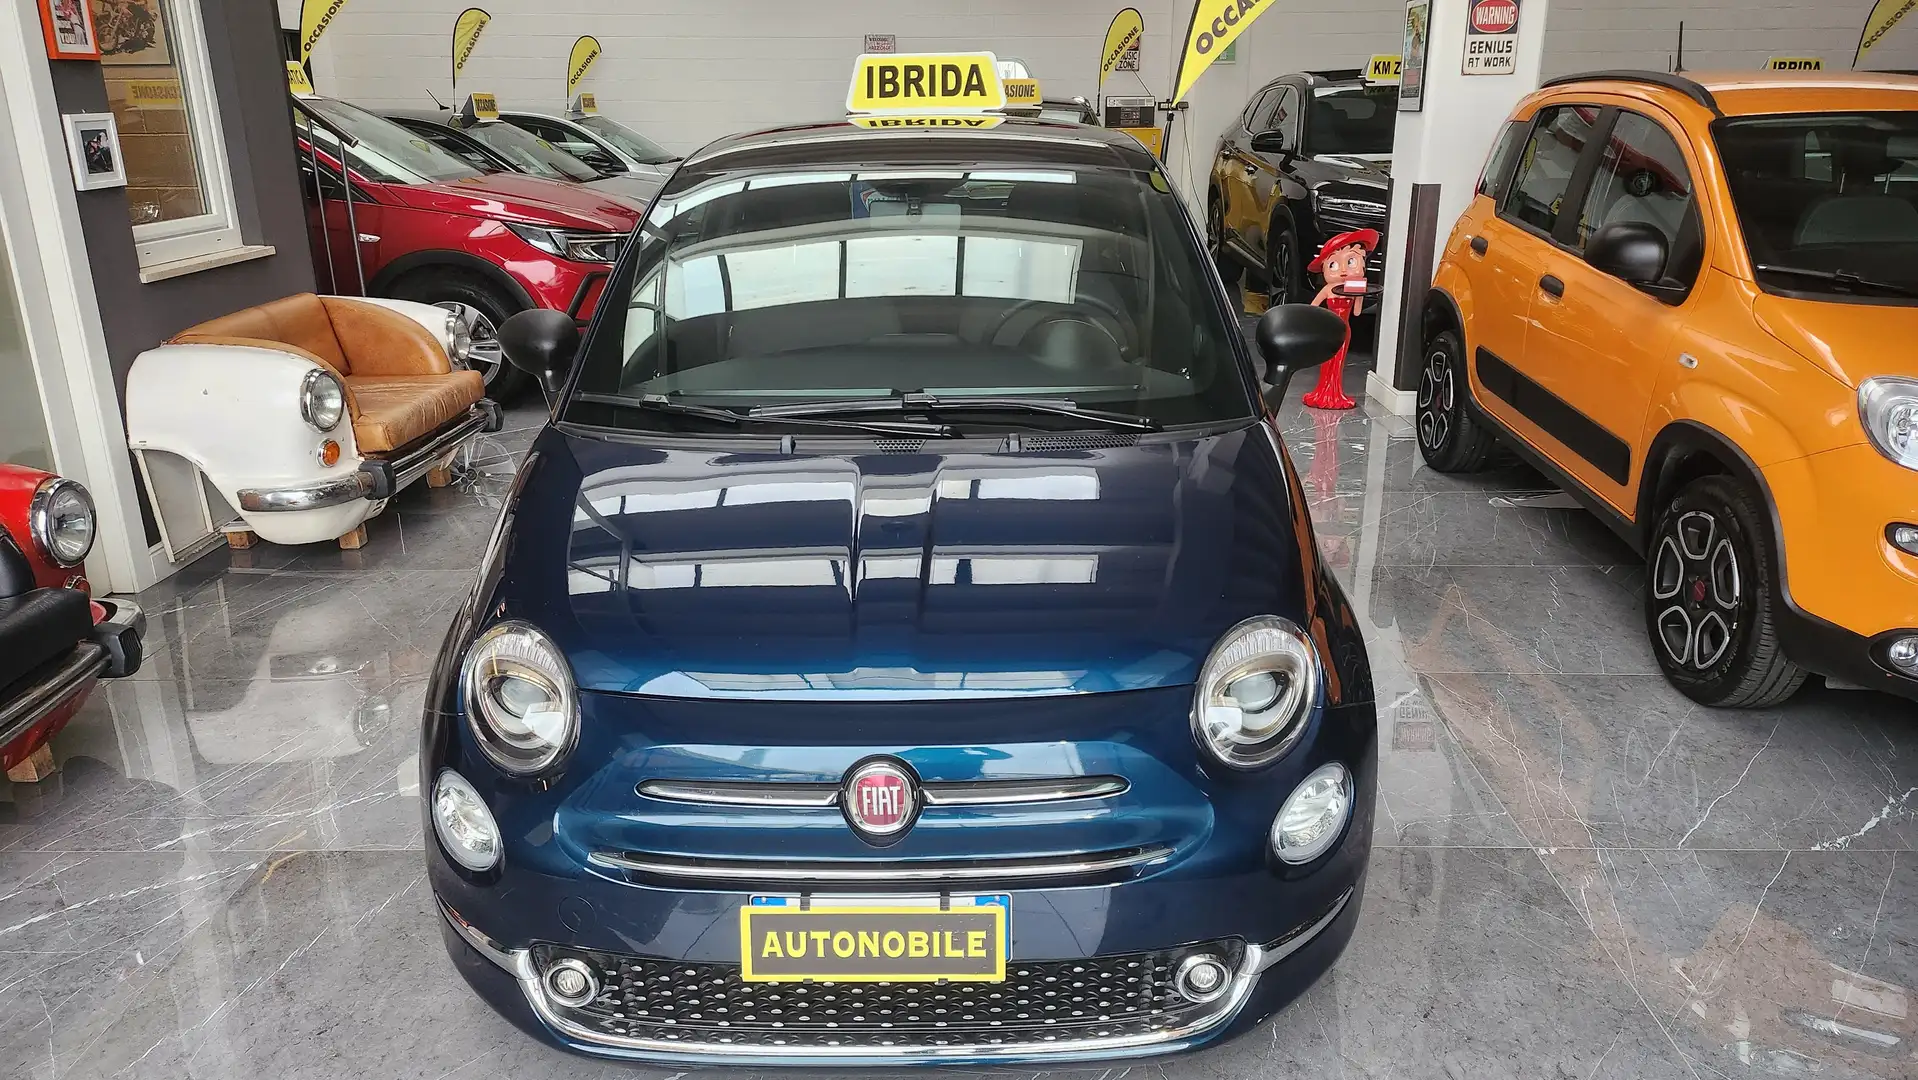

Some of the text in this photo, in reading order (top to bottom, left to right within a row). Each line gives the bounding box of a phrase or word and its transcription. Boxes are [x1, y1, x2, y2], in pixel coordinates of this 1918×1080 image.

[1196, 0, 1260, 54] OCCA
[1476, 6, 1516, 25] WARNING
[457, 19, 487, 70] OCCASIONE
[1103, 26, 1139, 71] OCCASIONE
[1470, 40, 1513, 54] GENIUS
[570, 49, 598, 85] OCCASIONE
[1119, 61, 1136, 69] ZONE
[1374, 61, 1391, 75] KM
[1468, 57, 1511, 67] AT WORK
[866, 64, 987, 98] IBRIDA
[862, 785, 901, 816] FIAT
[762, 930, 987, 958] AUTONOBILE
